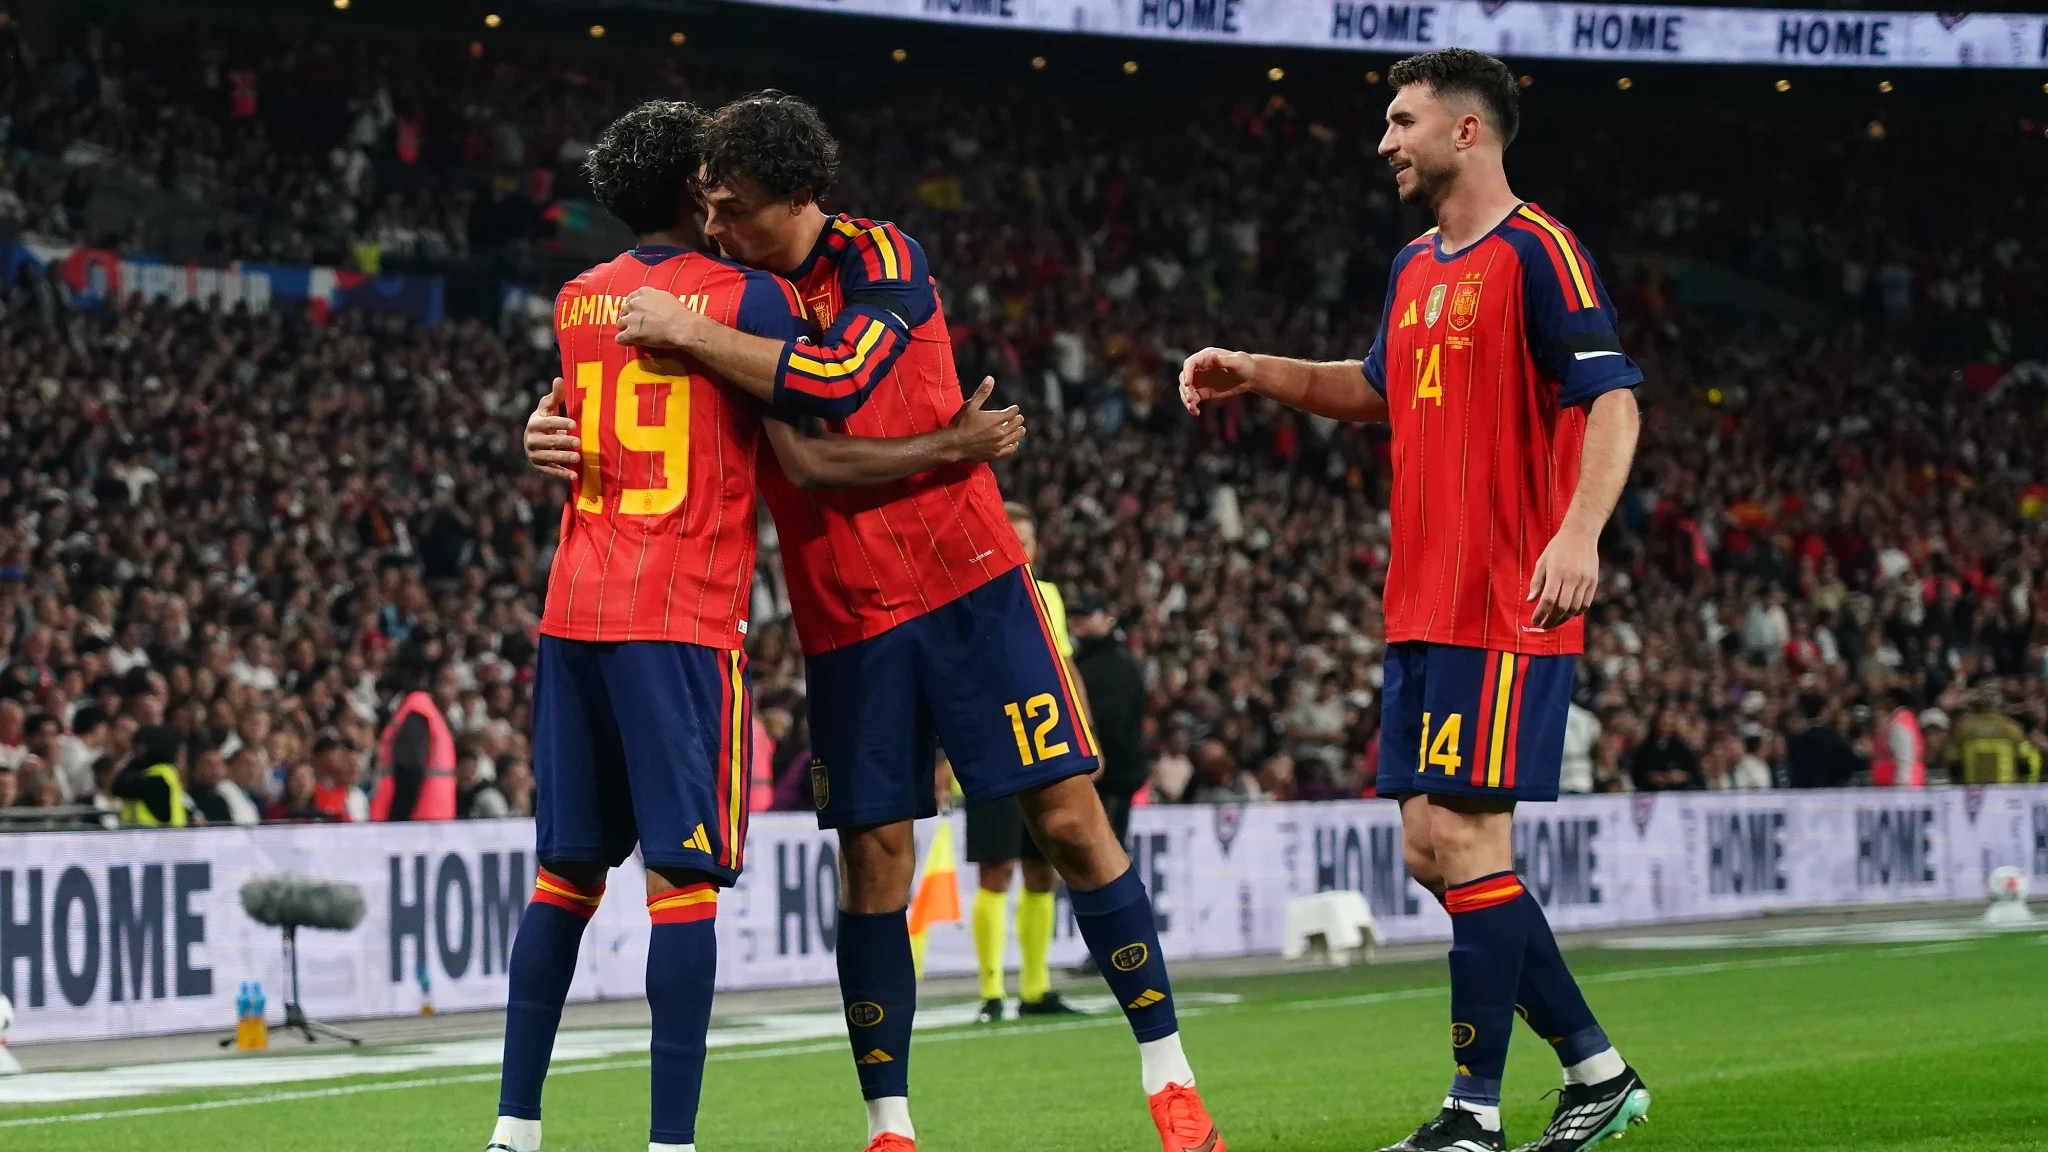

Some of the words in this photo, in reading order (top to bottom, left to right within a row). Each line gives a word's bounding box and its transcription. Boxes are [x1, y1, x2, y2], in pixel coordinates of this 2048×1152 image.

[1139, 0, 1241, 33] HOME
[1331, 3, 1435, 42] HOME
[1574, 14, 1682, 51] HOME
[1779, 19, 1890, 56] HOME
[560, 294, 628, 331] LAMIN
[1411, 343, 1443, 410] 14
[576, 357, 691, 515] 19
[1003, 692, 1071, 767] 12
[1417, 711, 1463, 777] 14
[0, 863, 213, 1008] HOME
[390, 852, 538, 987] HOM
